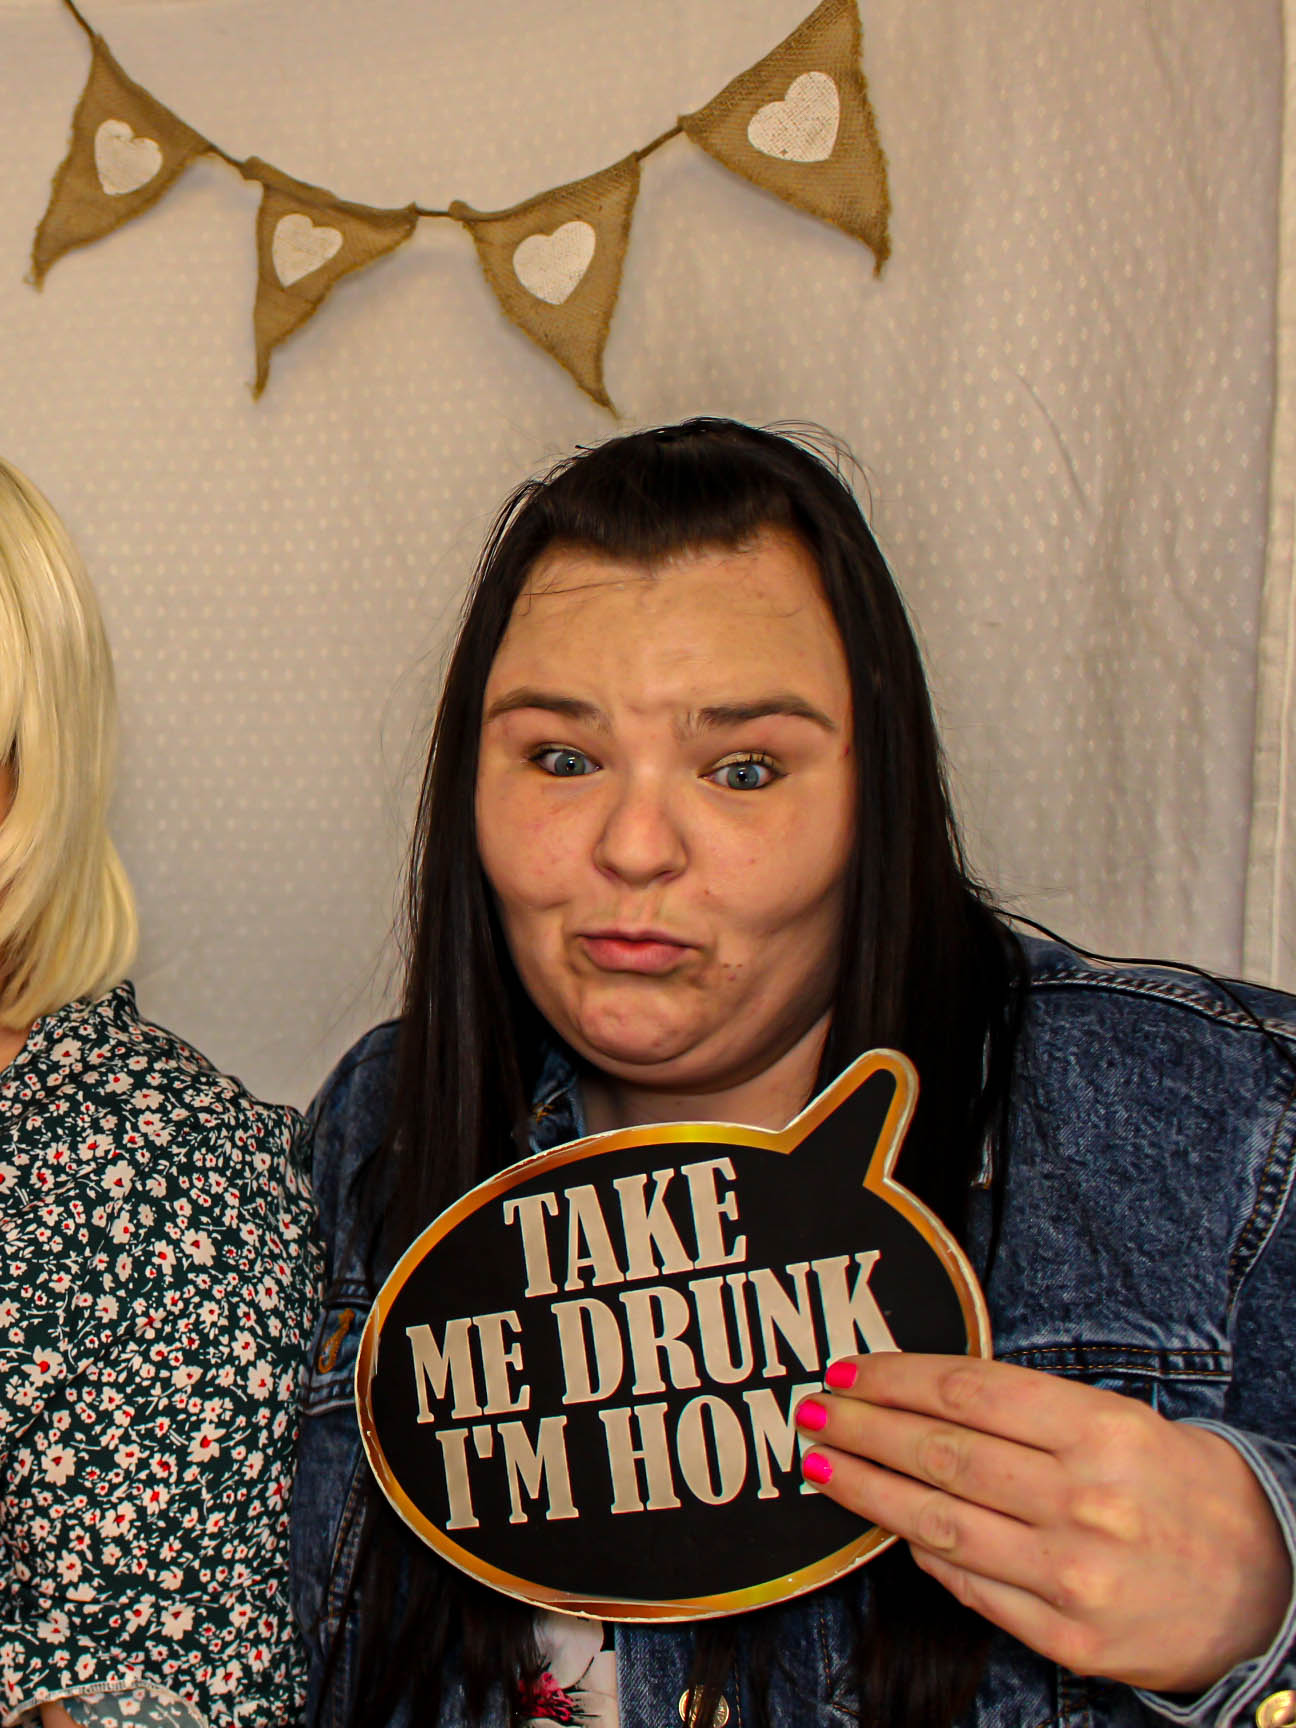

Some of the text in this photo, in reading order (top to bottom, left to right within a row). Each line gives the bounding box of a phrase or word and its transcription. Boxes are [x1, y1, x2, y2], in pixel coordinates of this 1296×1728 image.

[503, 1156, 746, 1298] TAKE
[406, 1250, 902, 1423] ME DRUNK
[435, 1382, 824, 1531] I'M HOM
